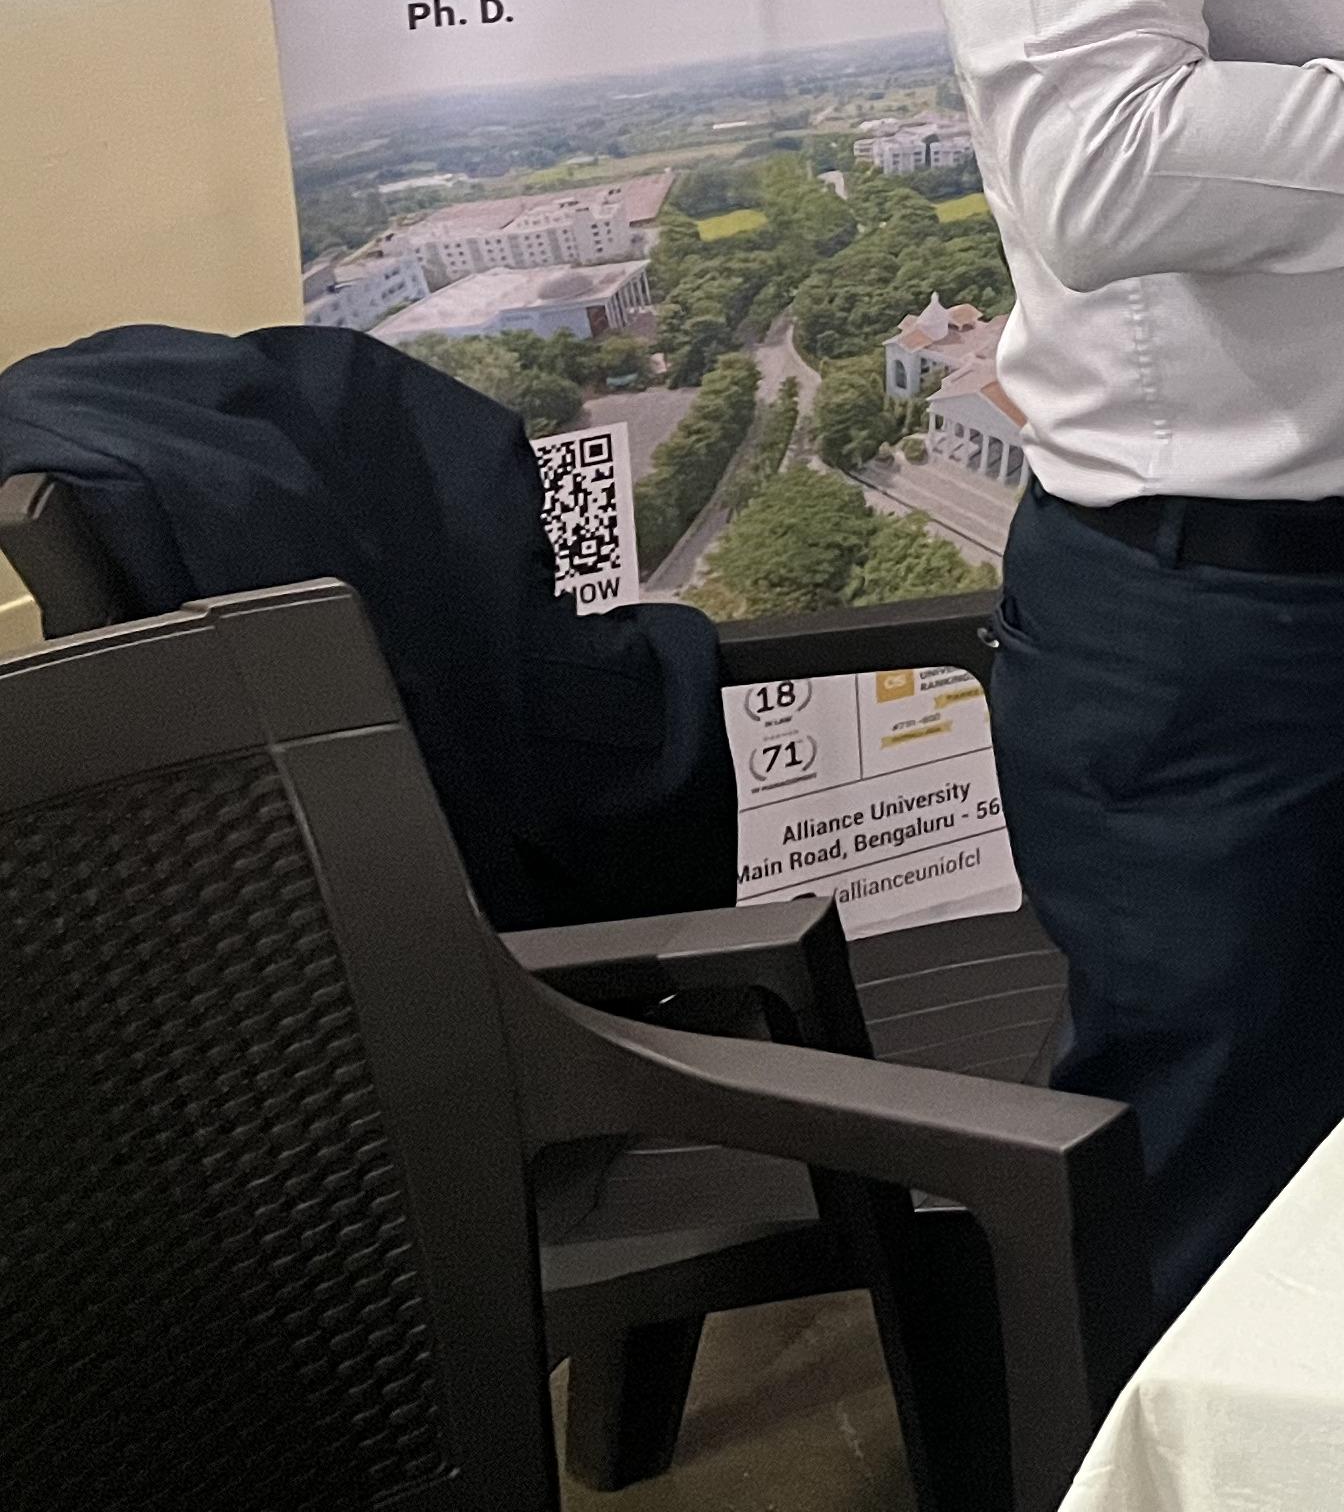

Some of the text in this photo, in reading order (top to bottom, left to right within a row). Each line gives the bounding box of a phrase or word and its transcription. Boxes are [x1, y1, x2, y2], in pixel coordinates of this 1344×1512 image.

[407, 0, 469, 31] Ph.
[756, 680, 796, 713] 18
[762, 741, 803, 773] 71
[782, 782, 972, 845] Alliance University
[789, 838, 848, 870] Road,
[854, 811, 956, 854] Bengaluru
